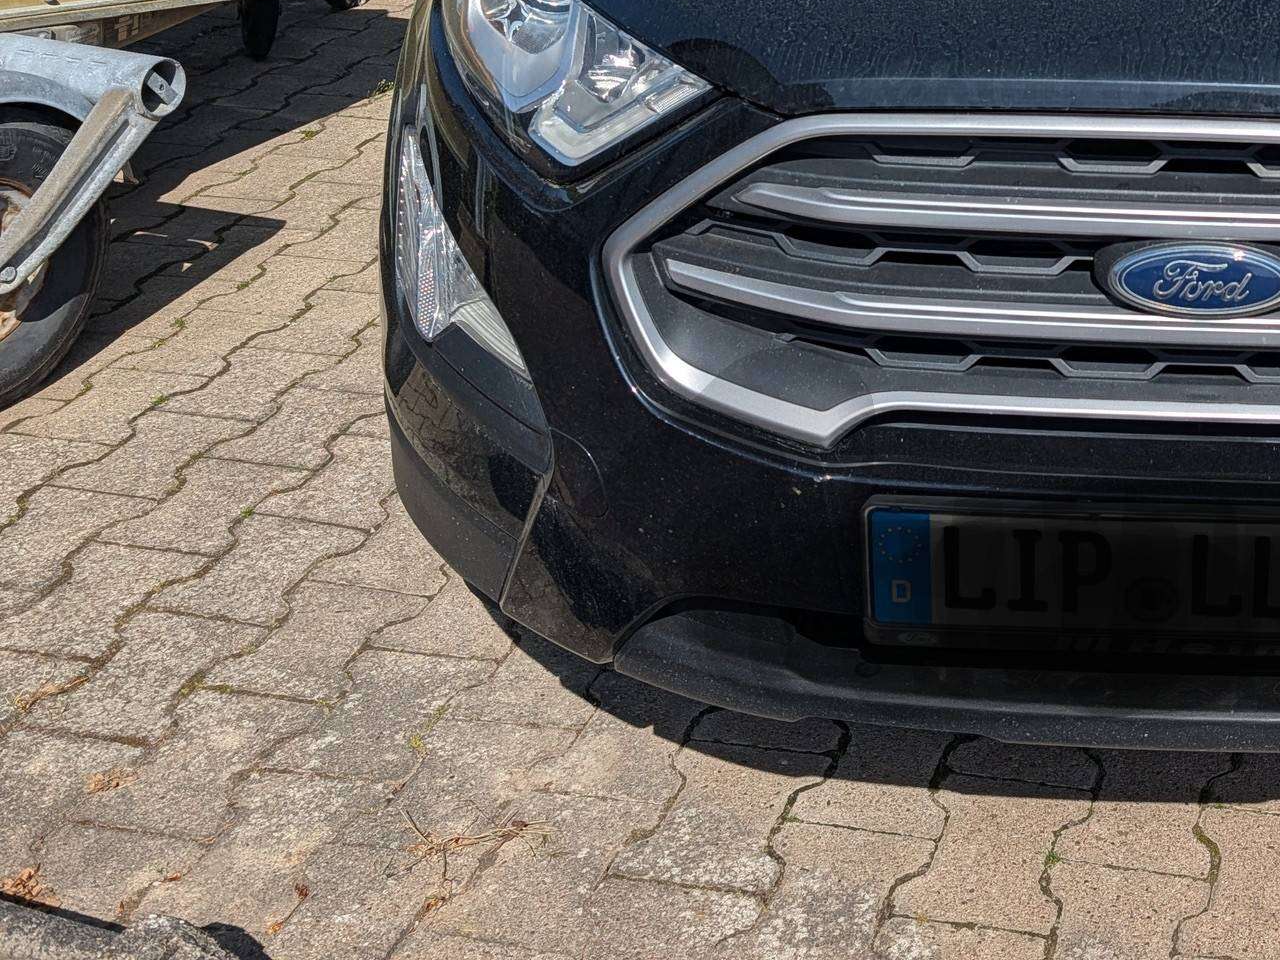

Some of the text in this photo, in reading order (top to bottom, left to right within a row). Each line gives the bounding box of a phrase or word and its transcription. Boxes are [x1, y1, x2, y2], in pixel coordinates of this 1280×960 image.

[1153, 259, 1252, 302] Ford
[942, 525, 1112, 613] LIP
[891, 579, 911, 603] D
